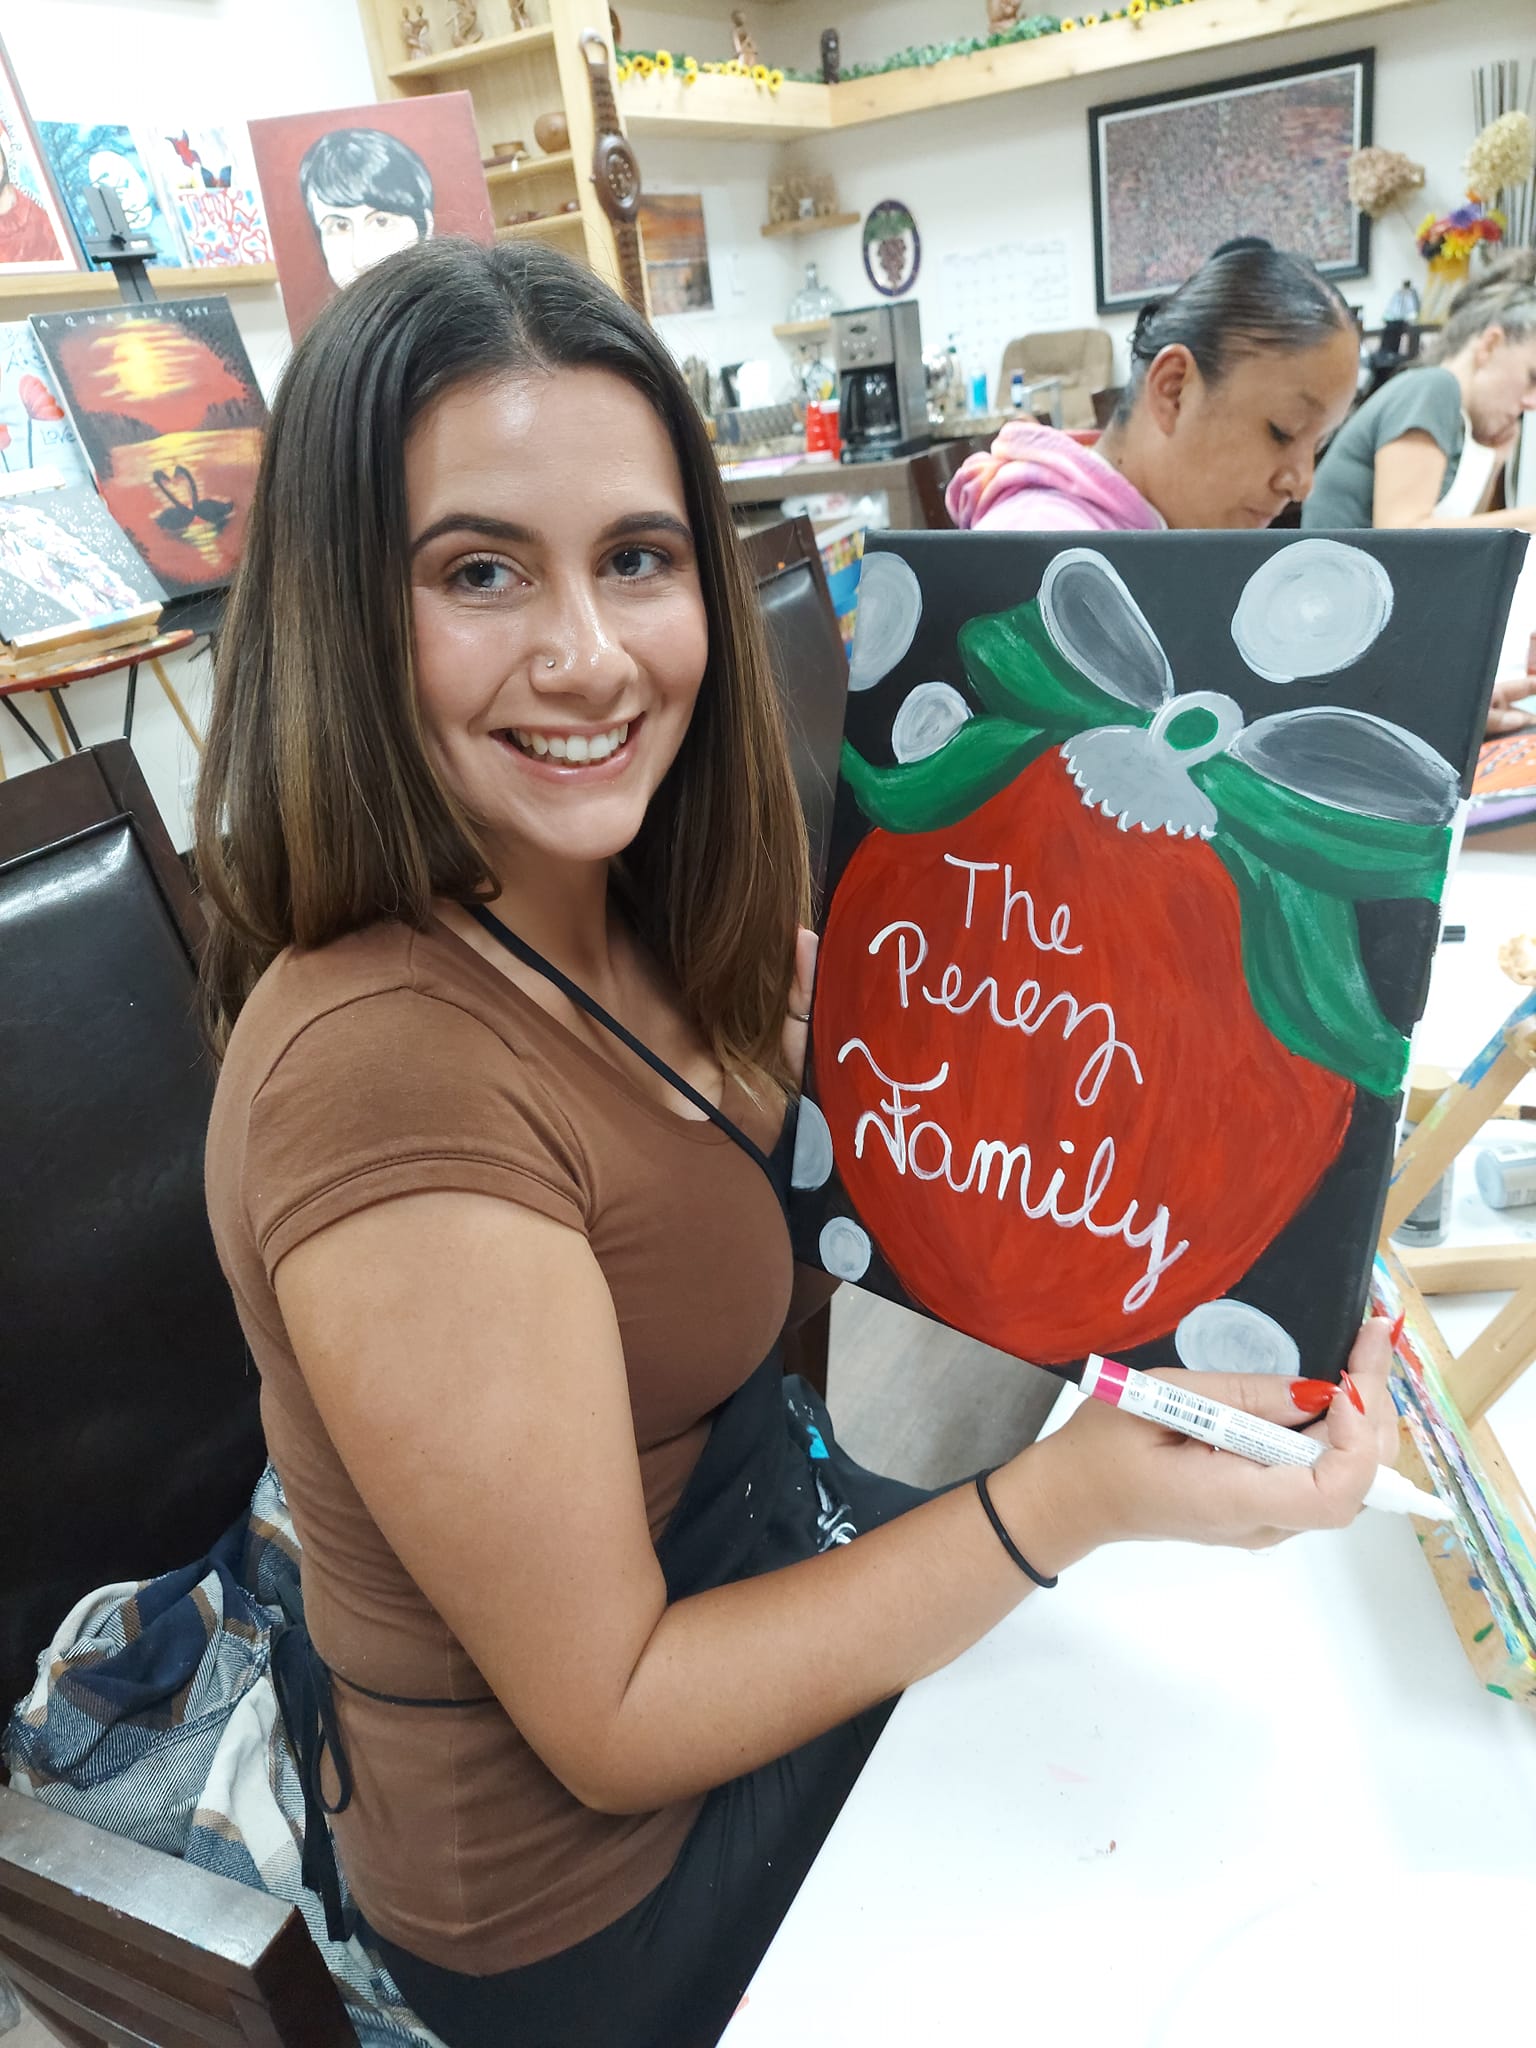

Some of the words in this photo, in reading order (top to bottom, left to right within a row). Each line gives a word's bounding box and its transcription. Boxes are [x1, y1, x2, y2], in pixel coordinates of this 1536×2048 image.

[943, 853, 1083, 954] The
[868, 920, 1143, 1106] Perez
[837, 1038, 1189, 1314] Family
